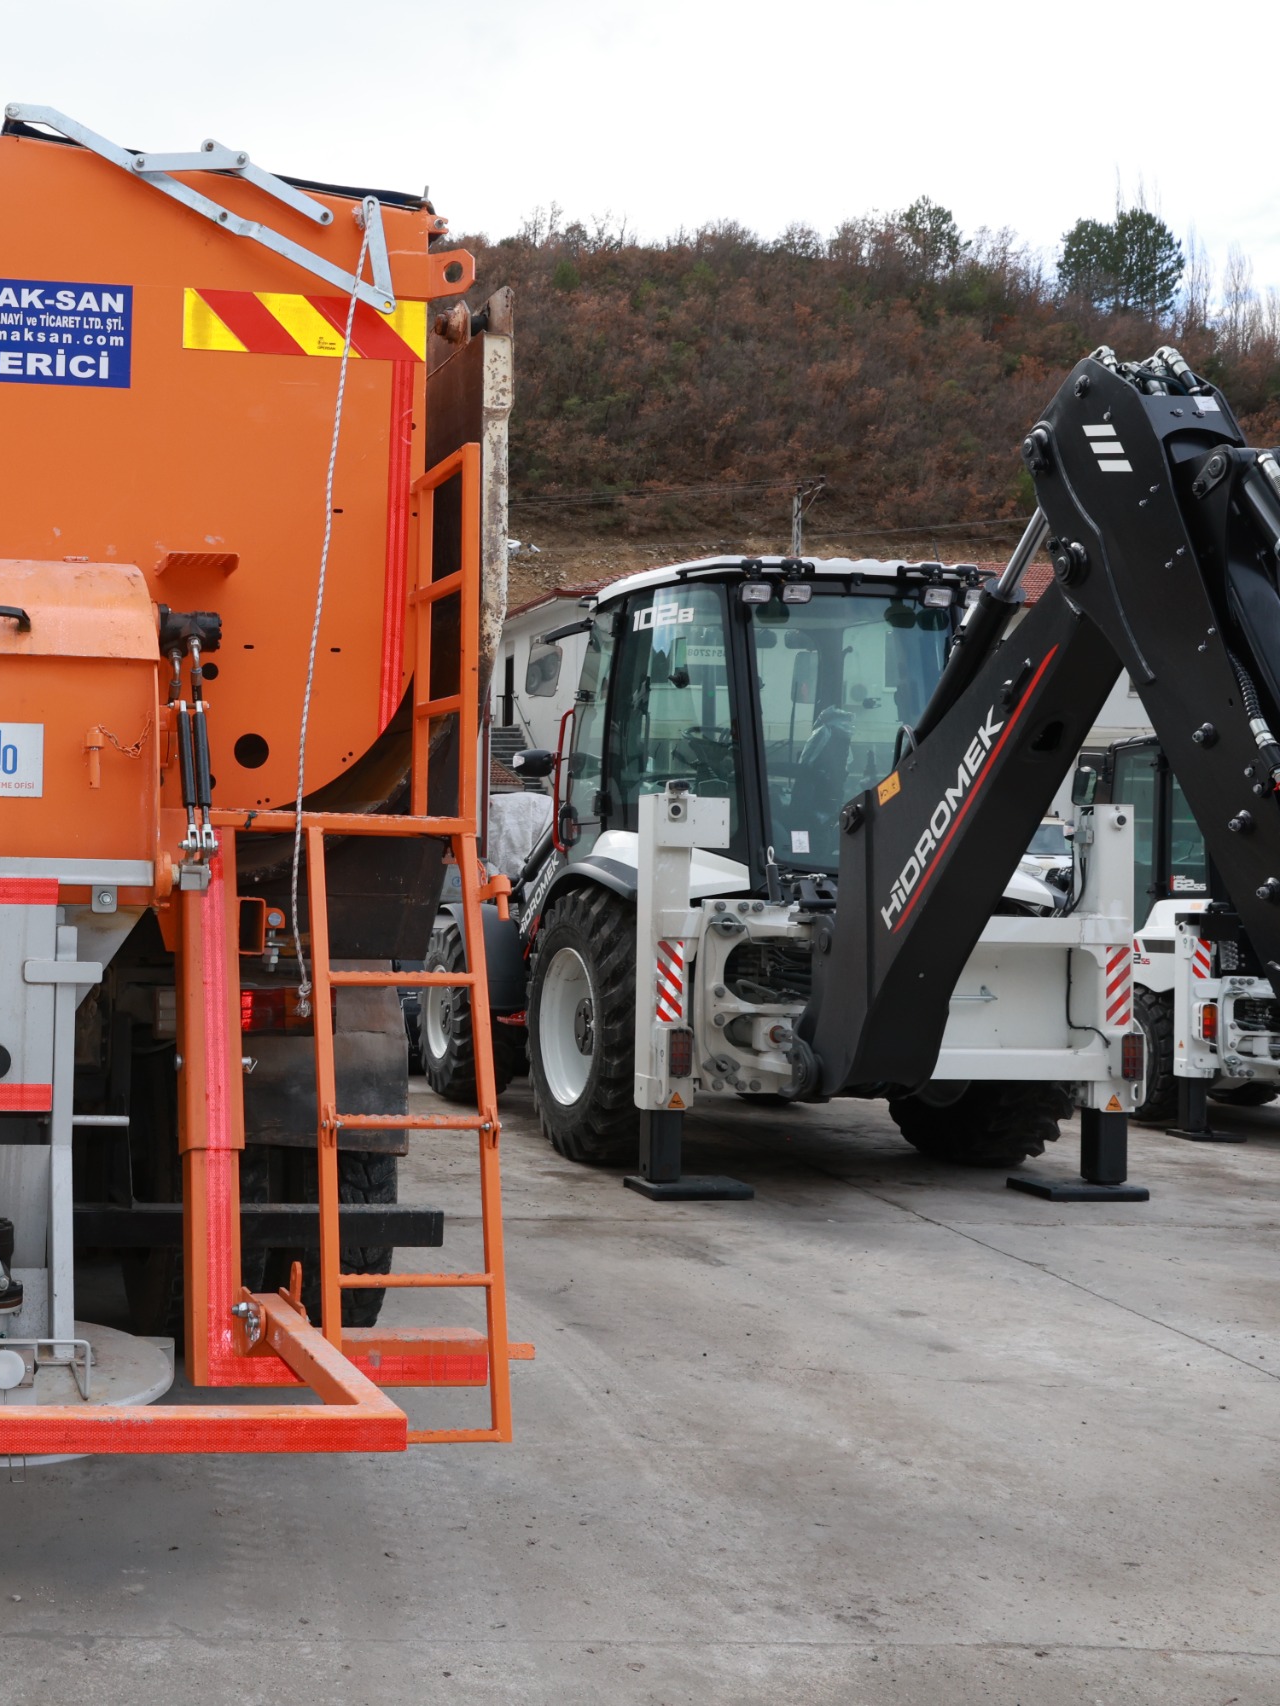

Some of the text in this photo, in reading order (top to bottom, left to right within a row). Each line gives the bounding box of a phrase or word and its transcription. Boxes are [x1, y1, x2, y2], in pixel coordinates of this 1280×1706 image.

[26, 317, 37, 326] ve
[39, 312, 80, 328] TİCARET
[83, 316, 104, 330] LTD.
[106, 314, 124, 333] ŞTİ.
[14, 781, 34, 789] OFİSİ
